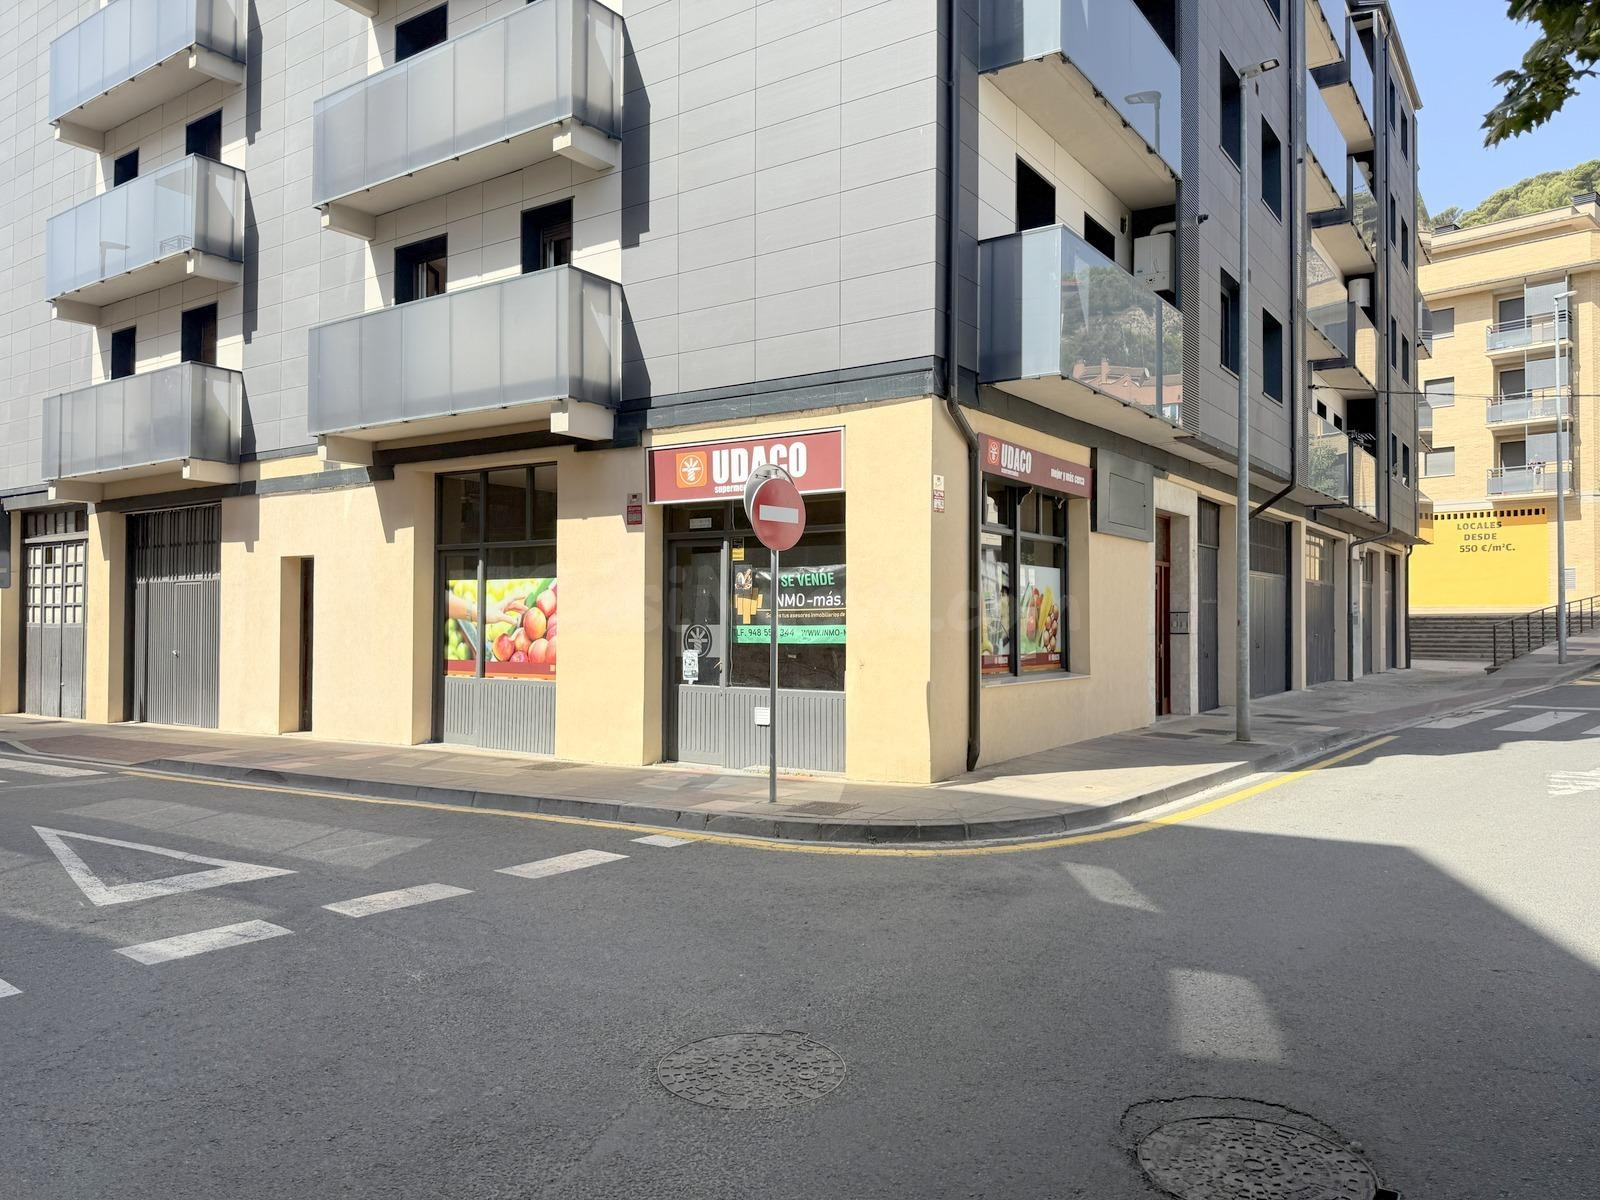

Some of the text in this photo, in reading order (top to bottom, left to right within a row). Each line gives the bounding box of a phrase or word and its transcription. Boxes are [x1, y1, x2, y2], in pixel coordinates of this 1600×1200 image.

[712, 441, 807, 484] UDACO
[1001, 443, 1032, 474] UDACO
[1456, 521, 1502, 531] LOCALES
[1464, 532, 1497, 541] DESDE
[1459, 544, 1478, 553] 550
[781, 572, 835, 587] SE VENDE
[749, 628, 761, 637] 948
